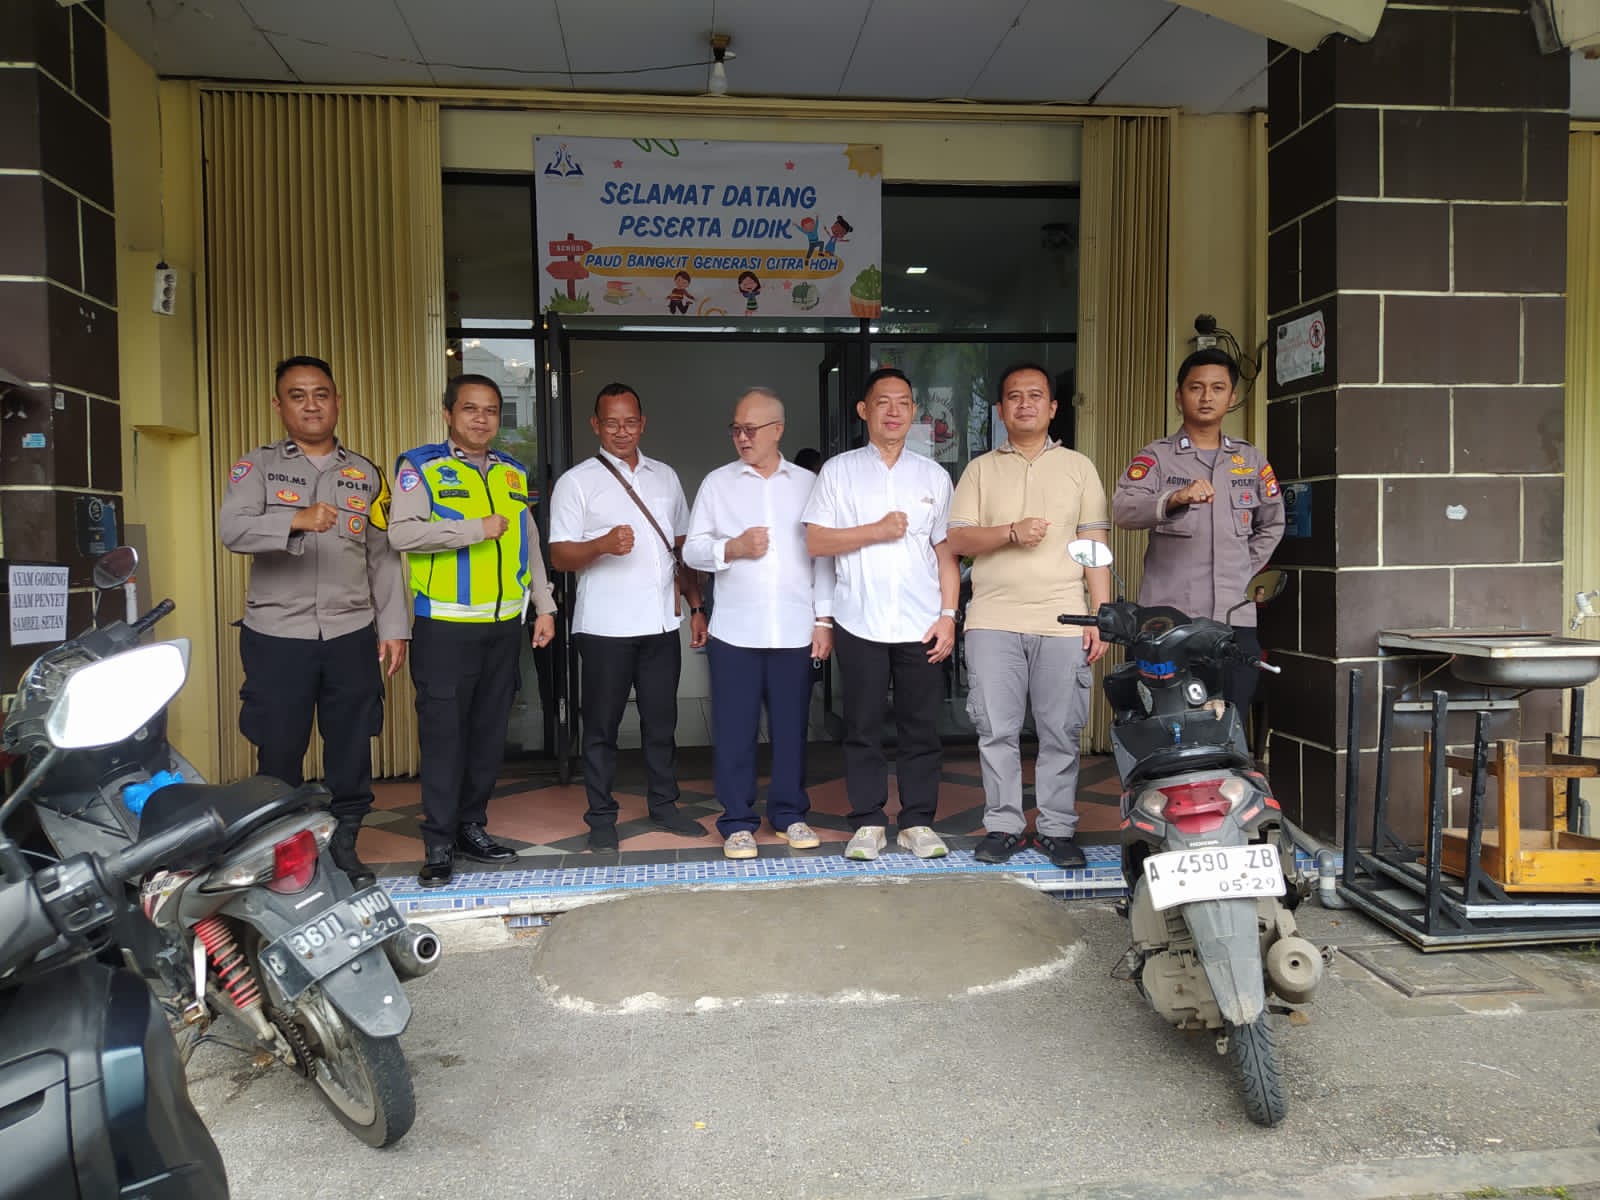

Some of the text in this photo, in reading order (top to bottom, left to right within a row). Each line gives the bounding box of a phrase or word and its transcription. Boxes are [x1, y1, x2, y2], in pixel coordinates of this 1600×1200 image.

[599, 181, 817, 209] SELAMAT DATANG
[618, 215, 793, 240] PESERTA DIDIK
[584, 254, 622, 268] PAUD
[627, 254, 689, 269] BANGKIT
[693, 255, 762, 271] GENERASI
[766, 256, 805, 271] CITRA
[338, 480, 373, 492] POLRI
[34, 572, 66, 586] GORENG
[12, 593, 33, 608] AYAM
[1149, 848, 1274, 882] A 4590 ZB
[289, 913, 345, 956] 3611
